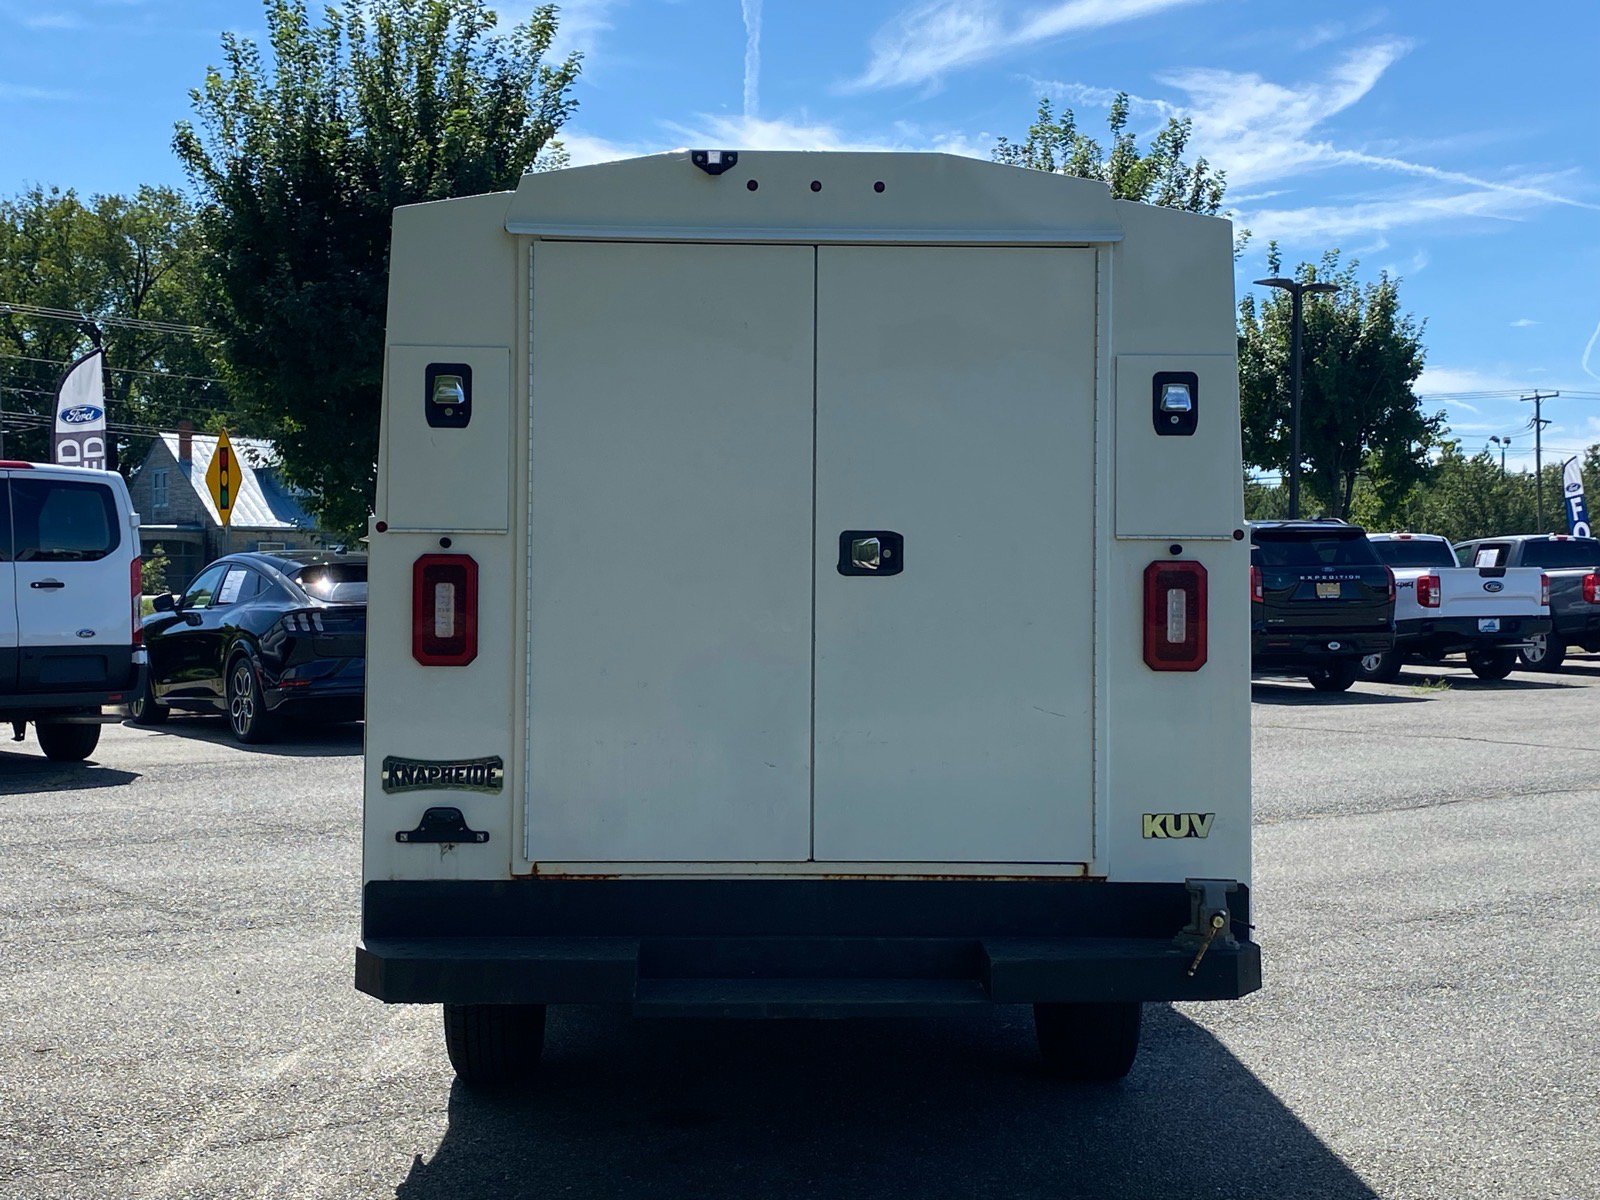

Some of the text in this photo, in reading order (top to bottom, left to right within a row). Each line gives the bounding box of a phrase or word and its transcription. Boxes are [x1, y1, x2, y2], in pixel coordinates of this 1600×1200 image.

[66, 407, 95, 422] Ford
[388, 761, 499, 789] KNAPHEIDE
[1142, 813, 1215, 839] KUV
